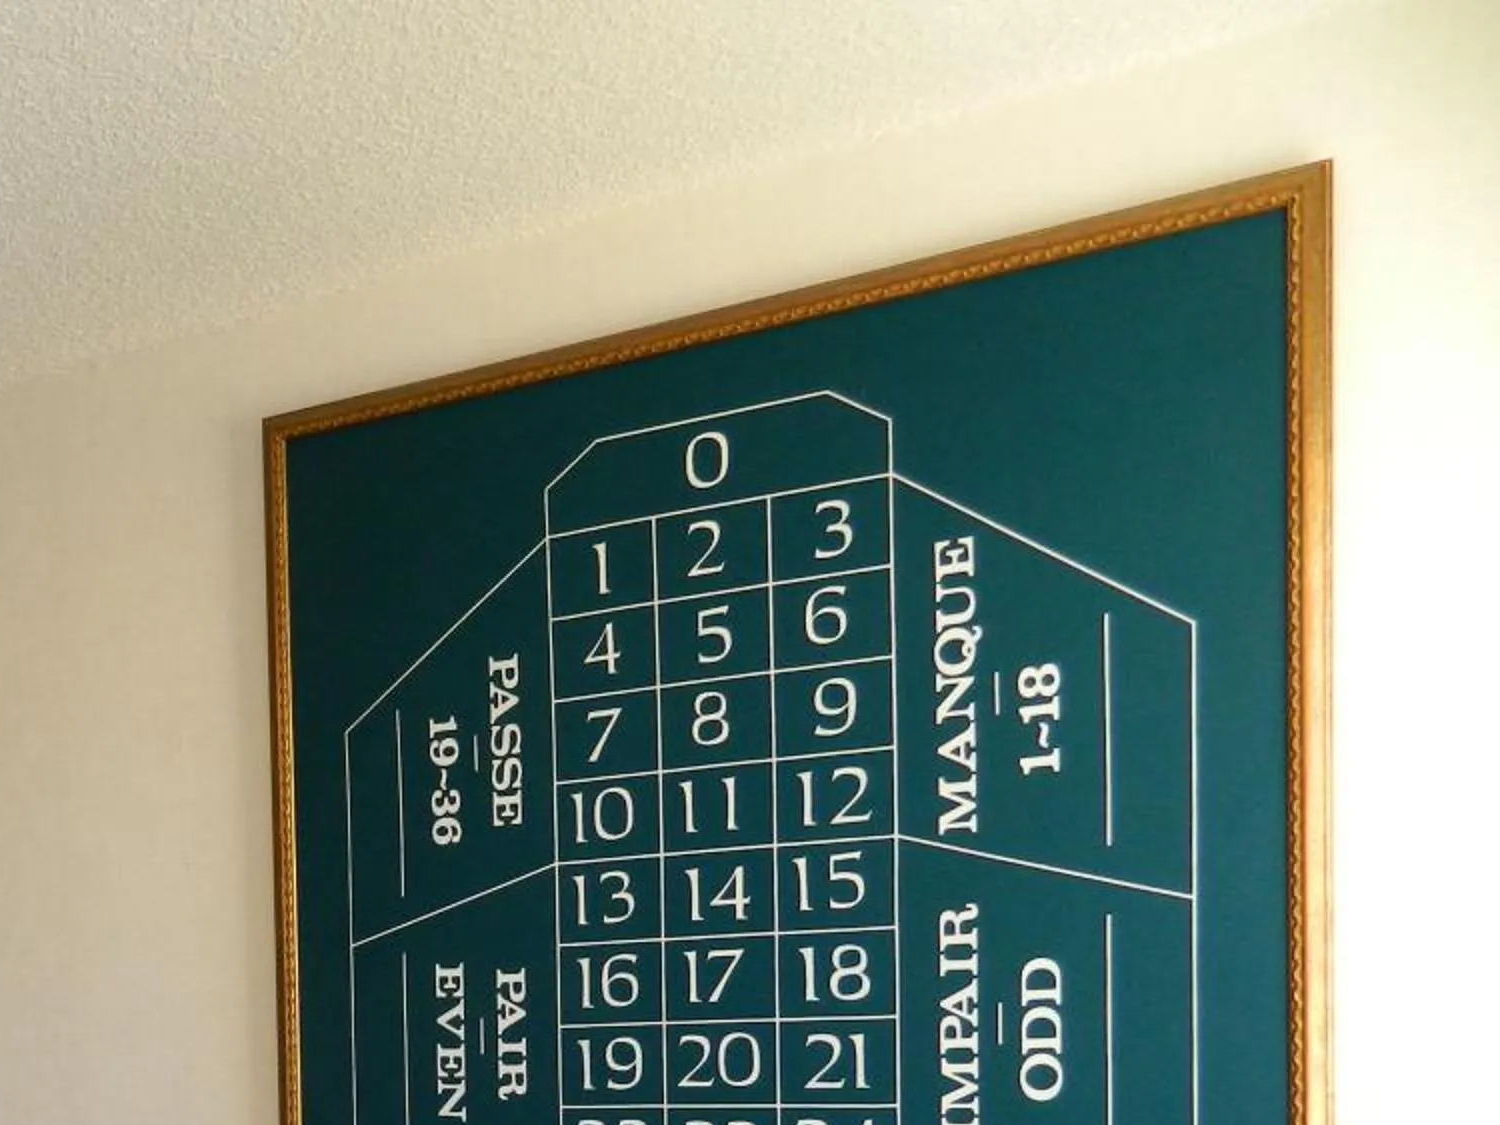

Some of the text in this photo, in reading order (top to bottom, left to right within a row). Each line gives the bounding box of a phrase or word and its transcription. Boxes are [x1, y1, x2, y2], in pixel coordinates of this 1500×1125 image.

[685, 431, 730, 489] 0
[687, 519, 725, 578] 2
[813, 498, 854, 559] 3
[591, 541, 612, 595] 1
[697, 604, 733, 664] 5
[804, 585, 848, 645] 6
[584, 621, 622, 675] 4
[813, 677, 858, 737] 9
[933, 535, 983, 837] MANQUE
[487, 652, 523, 827] PASSE
[586, 707, 623, 763] 7
[691, 691, 730, 747] 8
[570, 787, 634, 844] 10
[678, 776, 739, 834] 11
[796, 766, 873, 827] 12
[571, 870, 636, 926] 13
[684, 865, 752, 922] 14
[791, 850, 866, 912] 15
[576, 953, 640, 1009] 16
[683, 947, 745, 1004] 17
[798, 943, 872, 1002] 18
[434, 961, 467, 1123] EVEN
[495, 967, 528, 1101] PAIR
[1019, 957, 1065, 1103] ODD
[577, 1036, 643, 1091] 19
[677, 1031, 761, 1088] 20
[803, 1033, 871, 1090] 21
